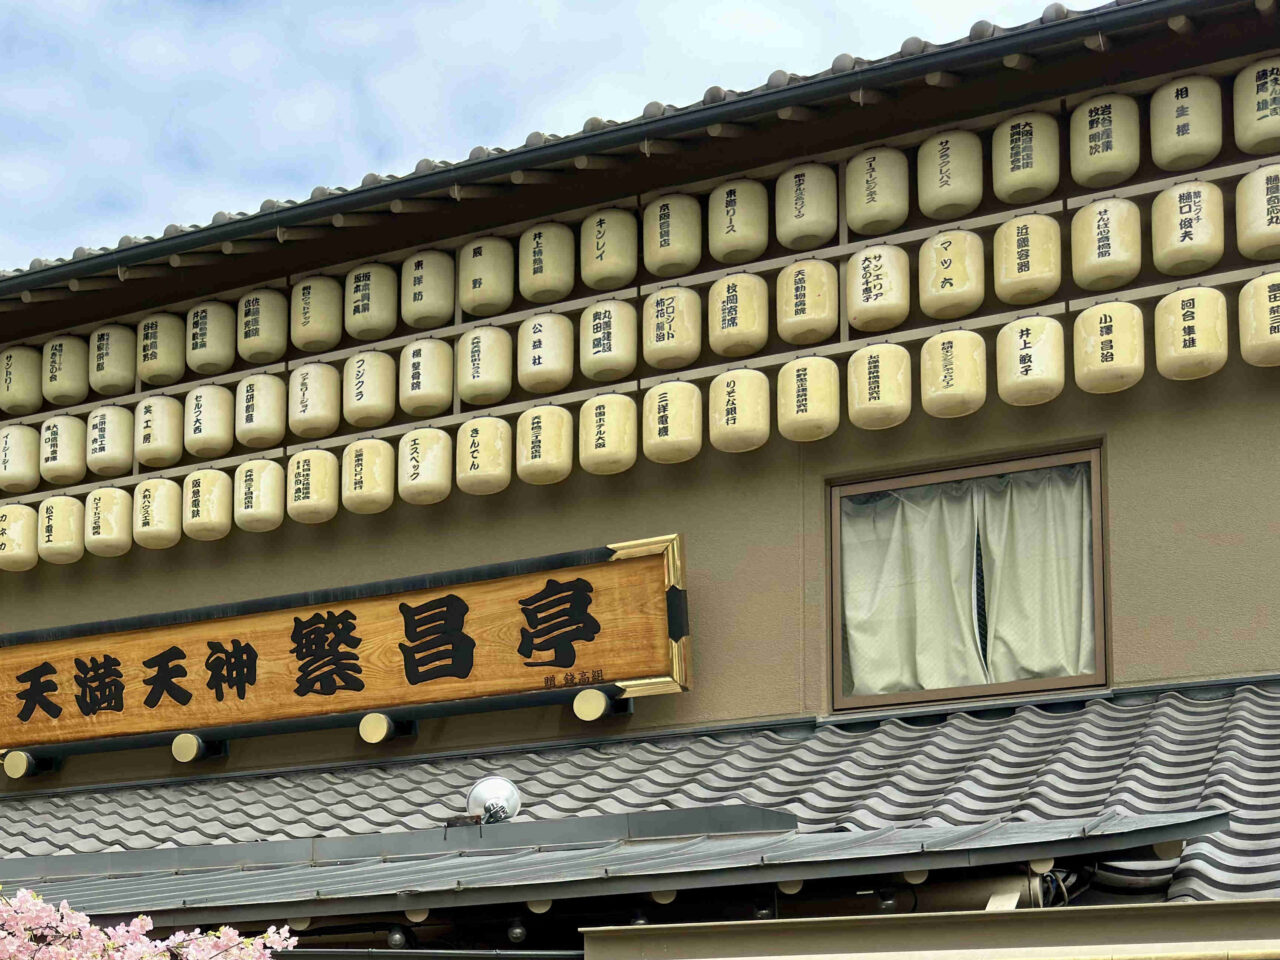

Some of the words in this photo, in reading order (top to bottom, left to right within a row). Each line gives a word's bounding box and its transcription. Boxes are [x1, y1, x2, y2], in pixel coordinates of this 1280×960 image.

[1100, 103, 1113, 152] 岩谷産業
[938, 139, 951, 187] サクラクレパス
[595, 217, 606, 261] キンレイ
[532, 323, 543, 367] 公益社
[5, 354, 13, 392] サントリー
[355, 359, 365, 402] フジクラ
[142, 405, 152, 444] 笑工房
[657, 392, 669, 437] 三洋電機
[725, 380, 736, 426] りそな銀行
[594, 405, 606, 449] 帝国ホテル大阪
[2, 433, 10, 472] イーシーシー
[410, 438, 420, 481] エスペック
[468, 428, 479, 471] きんでん
[191, 479, 201, 519] 阪急電鉄
[0, 514, 7, 551] カネカ
[45, 505, 54, 543] 松下電工
[16, 577, 601, 722] 天満天神繁昌亭
